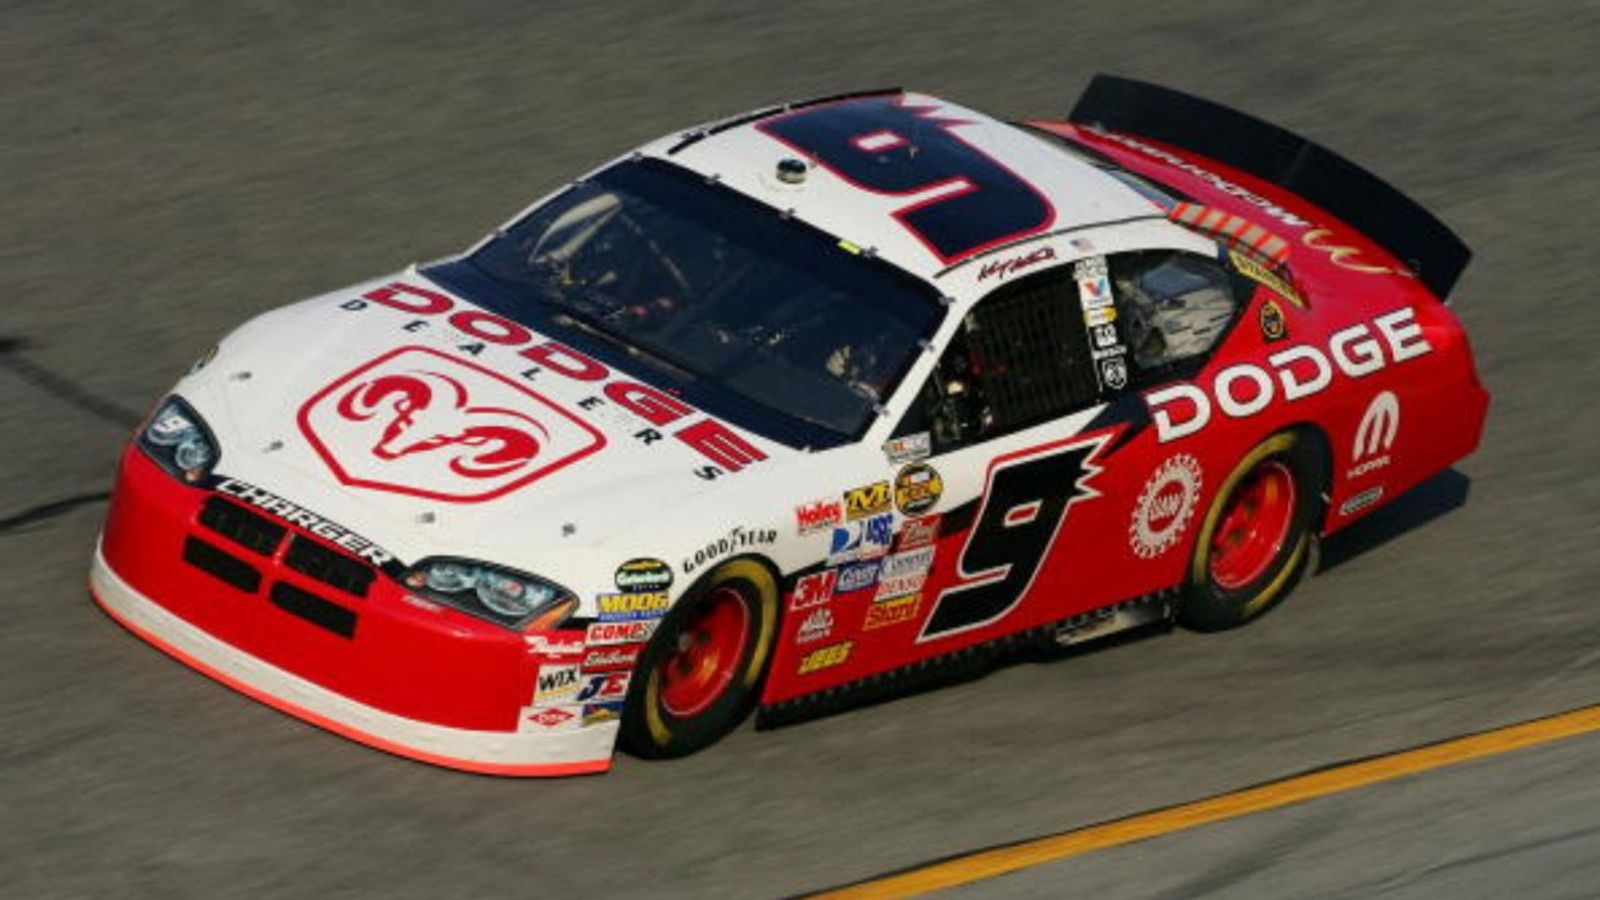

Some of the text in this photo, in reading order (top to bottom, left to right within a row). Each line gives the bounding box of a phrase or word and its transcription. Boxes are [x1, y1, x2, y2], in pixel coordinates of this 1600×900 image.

[340, 298, 724, 481] DEALERS
[361, 282, 769, 473] DODGE
[1145, 307, 1433, 443] DODGE
[216, 477, 394, 566] CHARGER
[683, 525, 777, 574] GOODYEAR
[915, 433, 1114, 643] 9
[793, 570, 838, 608] 3M
[538, 666, 578, 692] WIX
